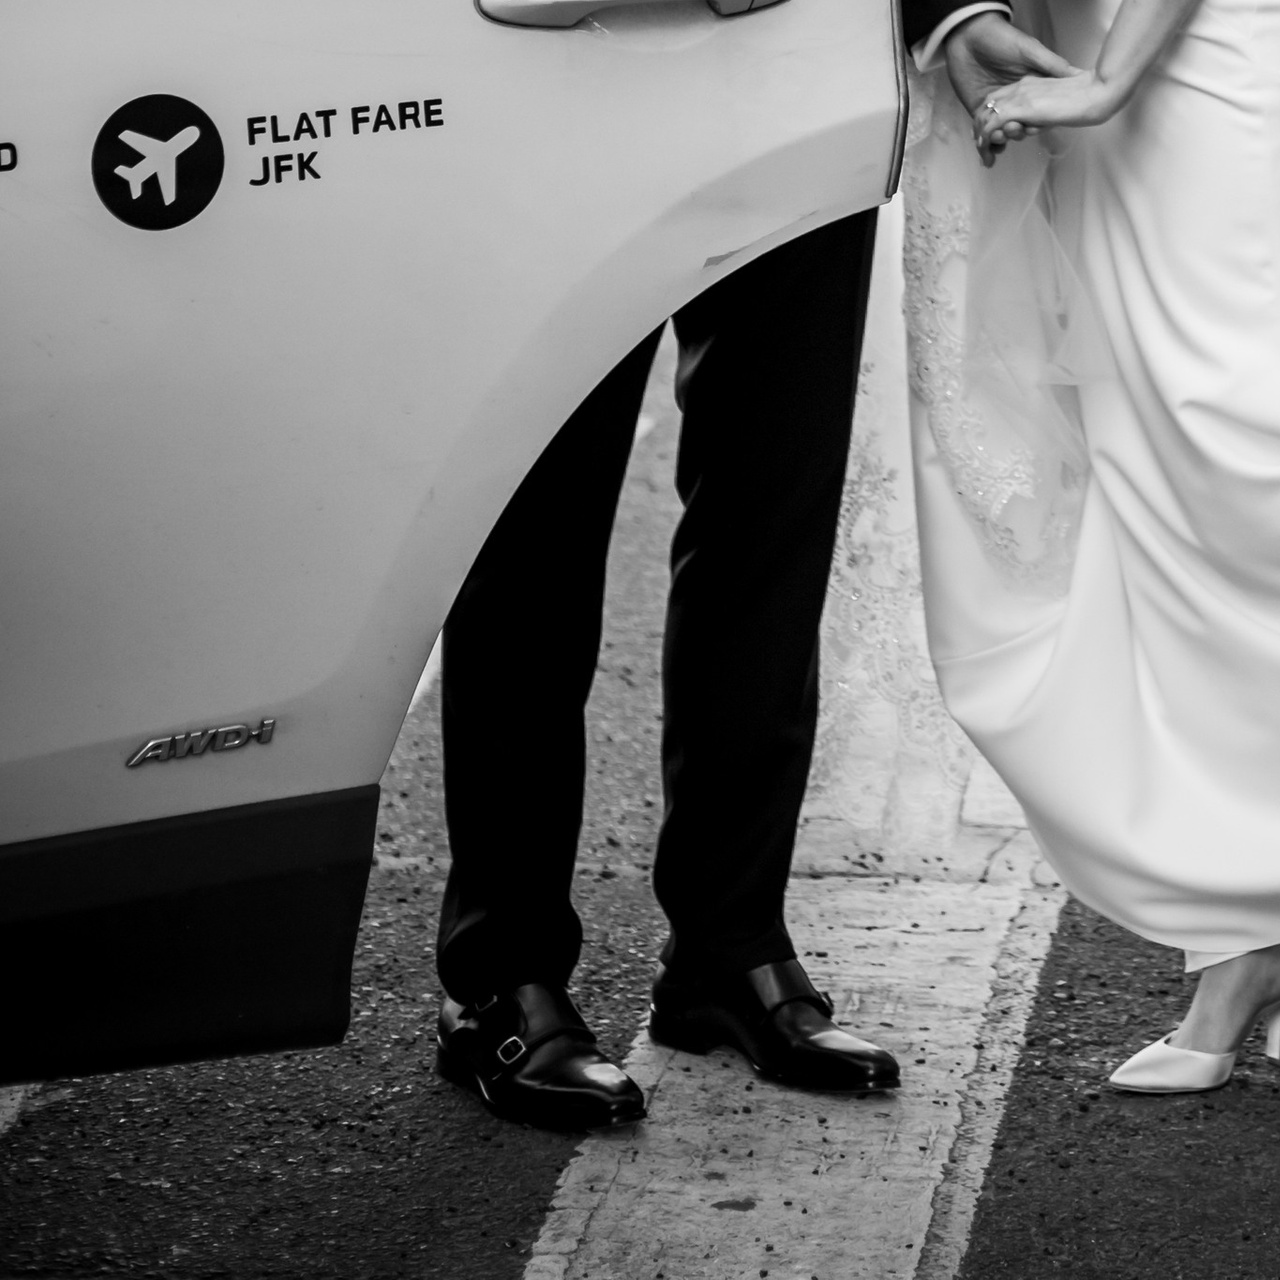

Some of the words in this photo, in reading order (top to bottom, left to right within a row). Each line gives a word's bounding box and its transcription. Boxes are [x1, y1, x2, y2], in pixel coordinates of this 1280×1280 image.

[246, 108, 338, 146] FLAT
[351, 98, 445, 136] FARE
[249, 151, 321, 187] JFK
